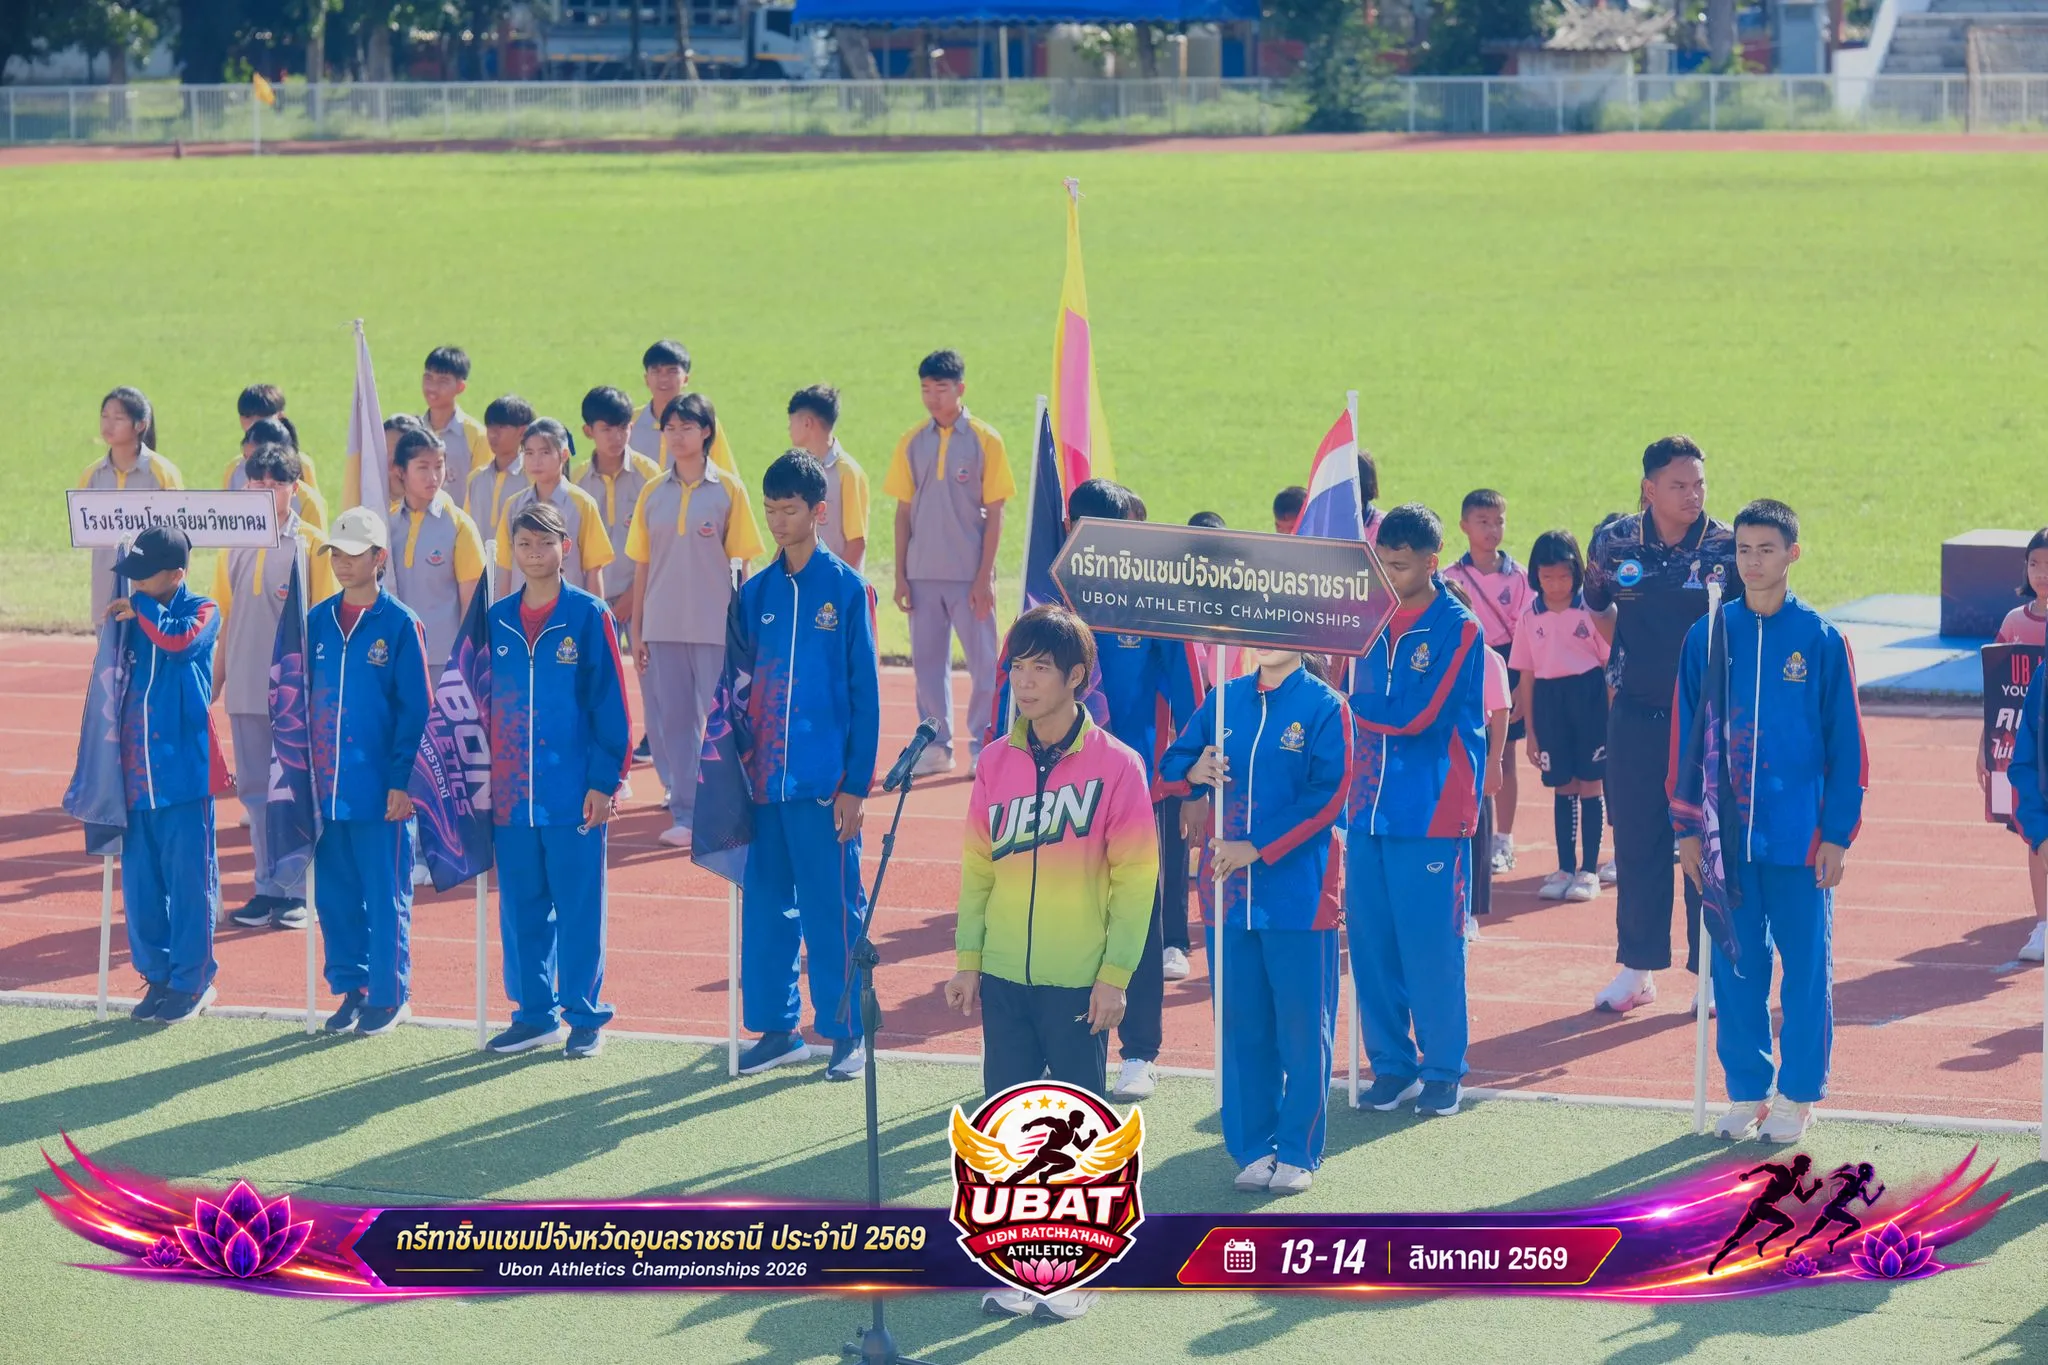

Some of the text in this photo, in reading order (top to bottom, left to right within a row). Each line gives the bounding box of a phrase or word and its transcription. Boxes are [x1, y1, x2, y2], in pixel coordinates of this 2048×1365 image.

[1082, 590, 1361, 628] UBON ATHLETICS CHAMPIONSHIPS
[988, 778, 1104, 862] UBN
